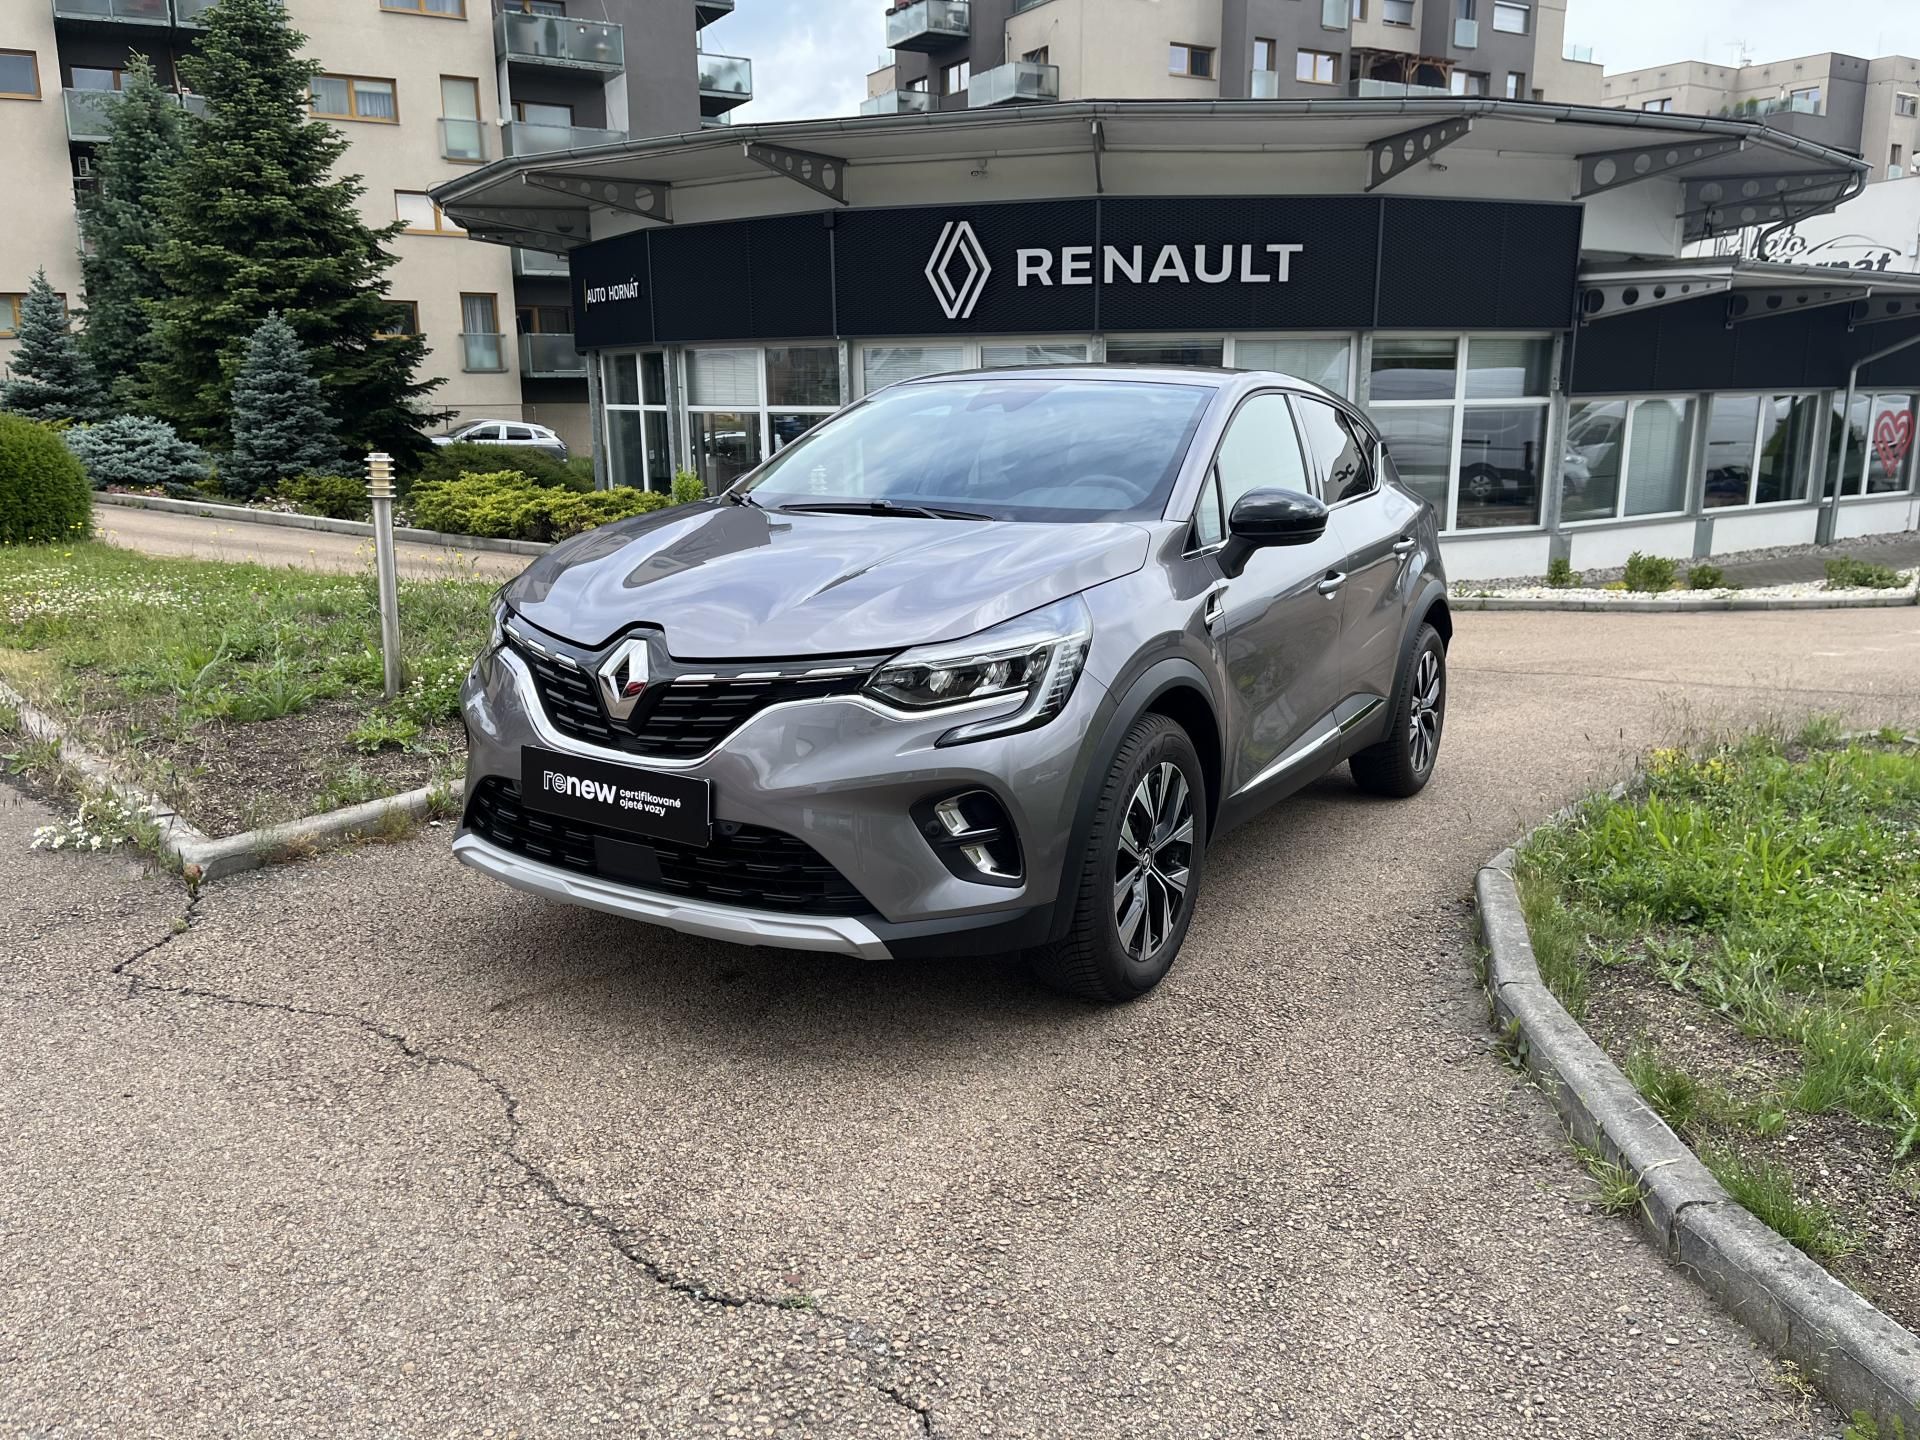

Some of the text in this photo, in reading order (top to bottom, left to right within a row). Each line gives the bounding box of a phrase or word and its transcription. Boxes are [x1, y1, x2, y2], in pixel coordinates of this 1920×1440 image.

[1016, 243, 1304, 287] RENAULT
[587, 277, 639, 304] AUTO HORNÁT
[543, 770, 617, 805] renew
[619, 789, 682, 808] certifikované
[619, 797, 666, 817] ojeté vozy
